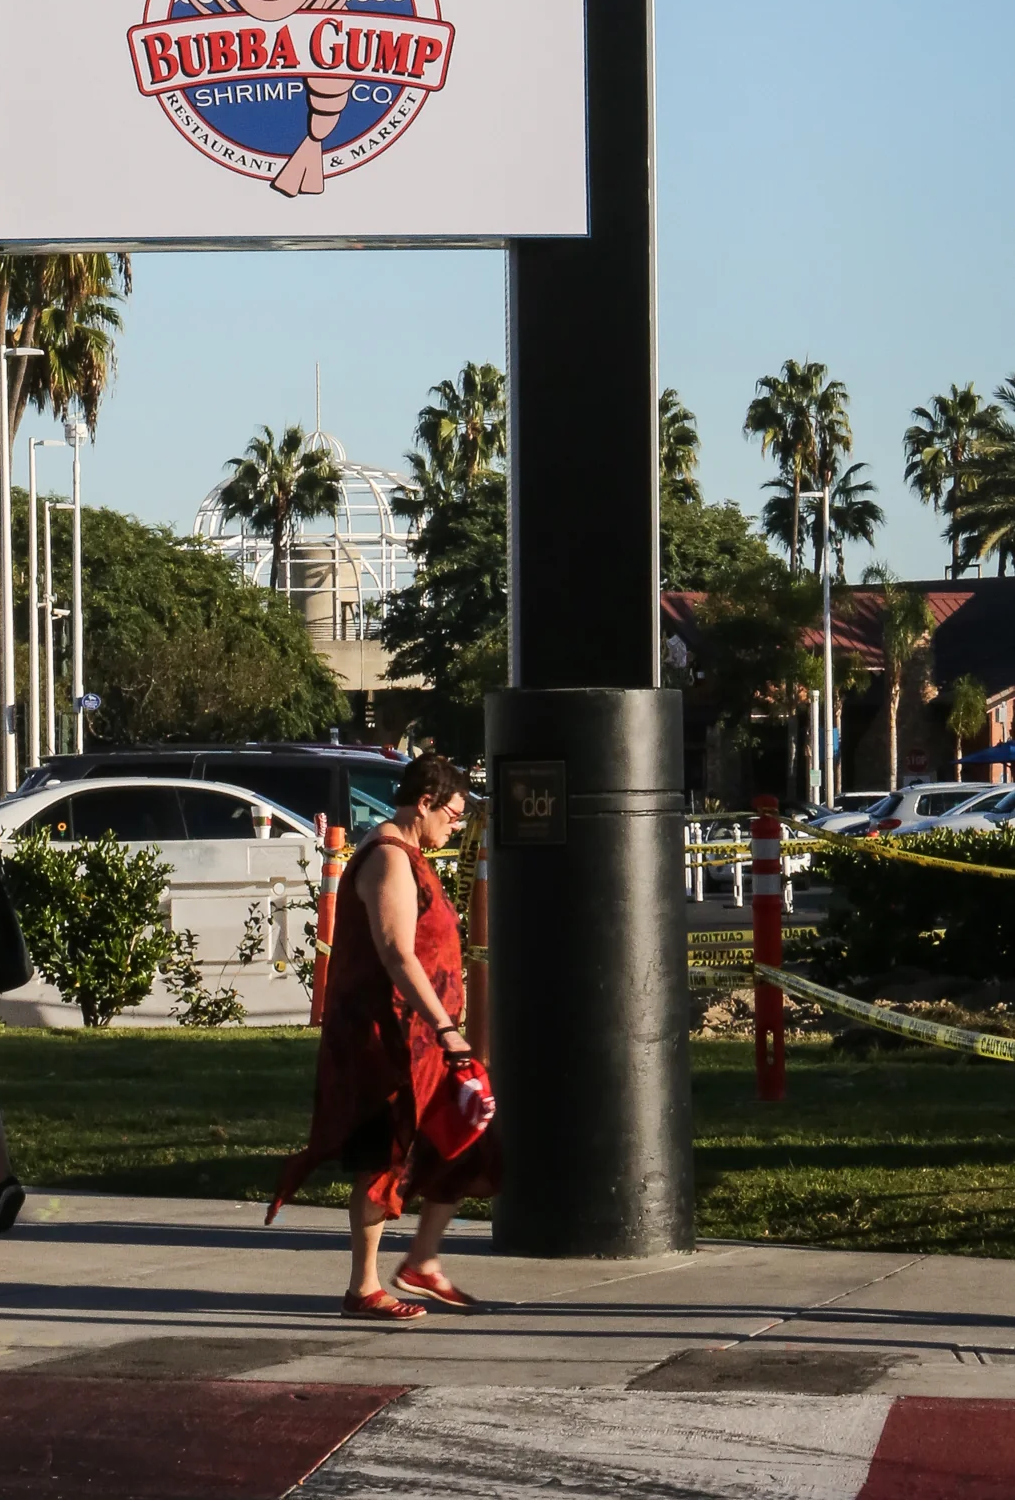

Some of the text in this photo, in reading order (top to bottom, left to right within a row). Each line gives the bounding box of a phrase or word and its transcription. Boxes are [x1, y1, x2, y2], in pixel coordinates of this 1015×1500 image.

[142, 17, 443, 85] BUBBA GUMP
[194, 82, 393, 107] SHRIMP CO.
[166, 92, 418, 173] RESTAURANT & MARKET
[522, 789, 556, 817] ddr
[456, 839, 480, 912] CAUTION
[980, 1036, 1014, 1059] CAUTION
